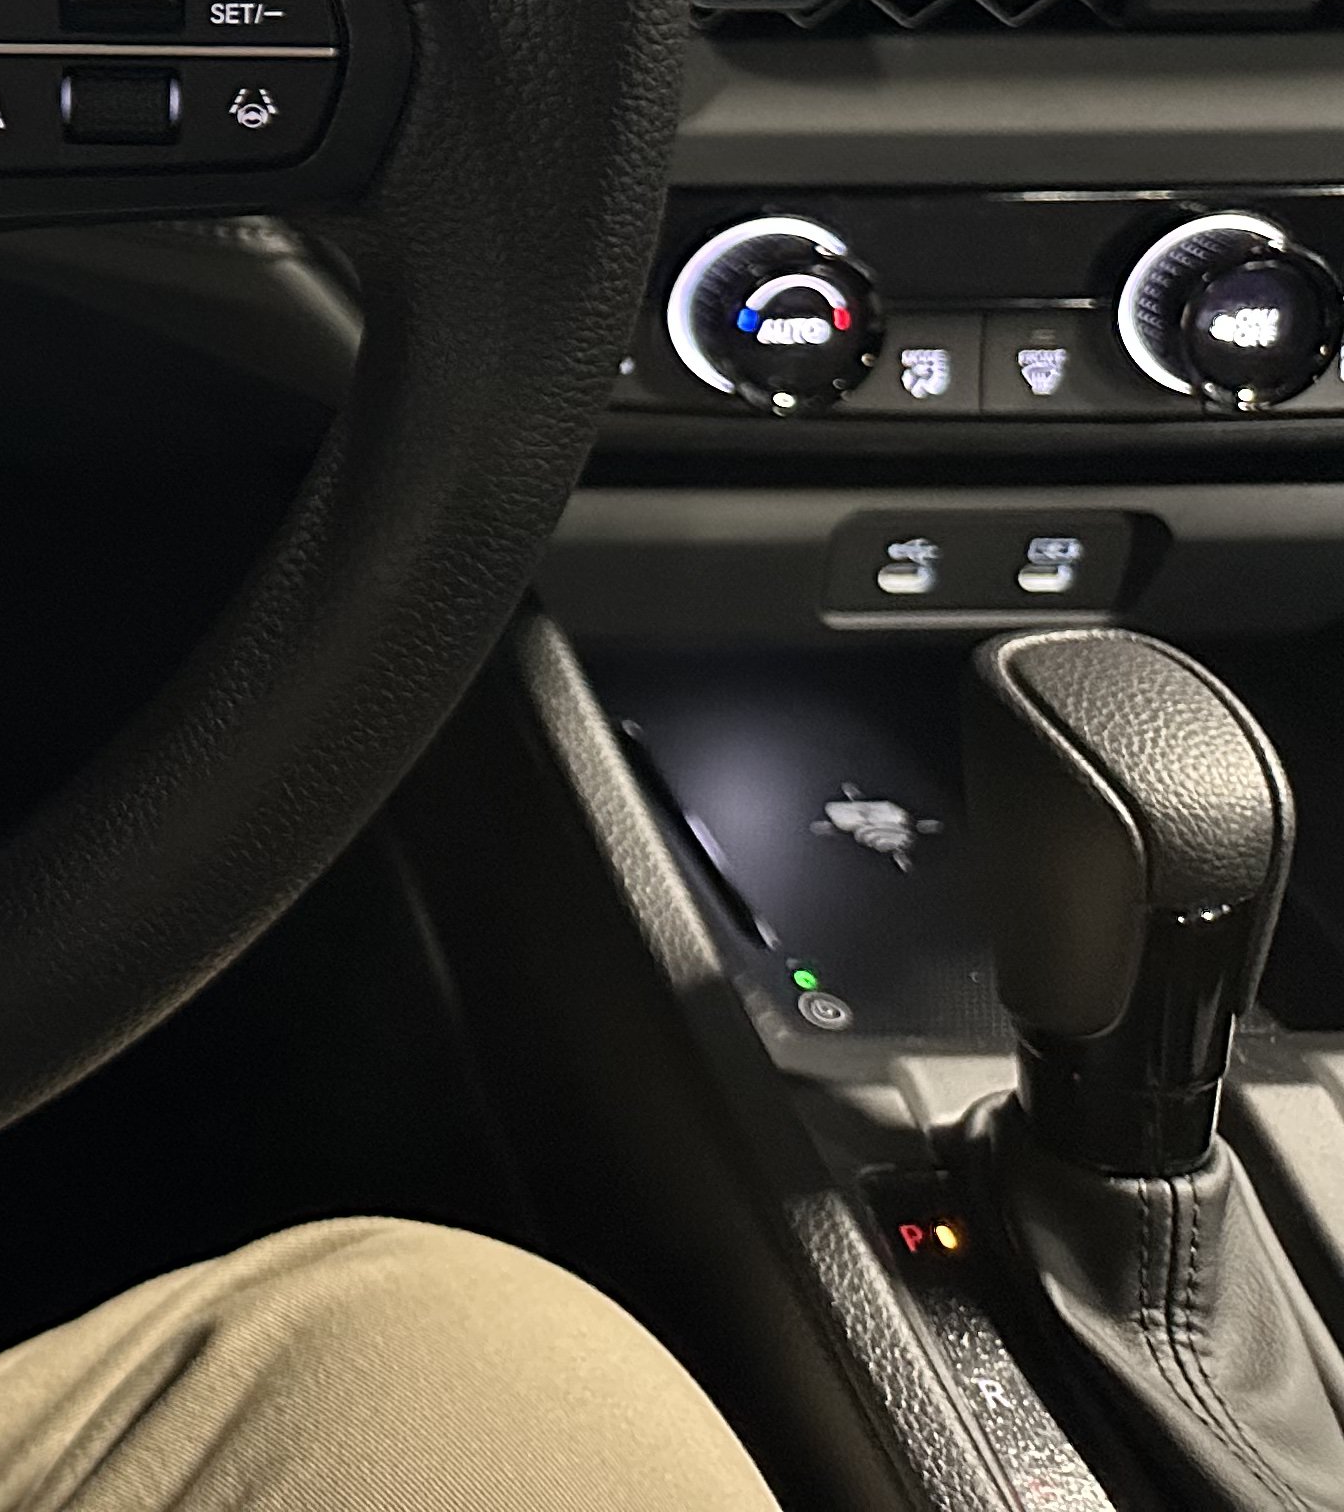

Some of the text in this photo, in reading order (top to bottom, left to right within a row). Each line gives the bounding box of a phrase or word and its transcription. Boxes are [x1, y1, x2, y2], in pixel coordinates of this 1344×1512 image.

[757, 318, 830, 344] AUTO
[899, 1224, 923, 1253] P
[977, 1378, 1013, 1411] R
